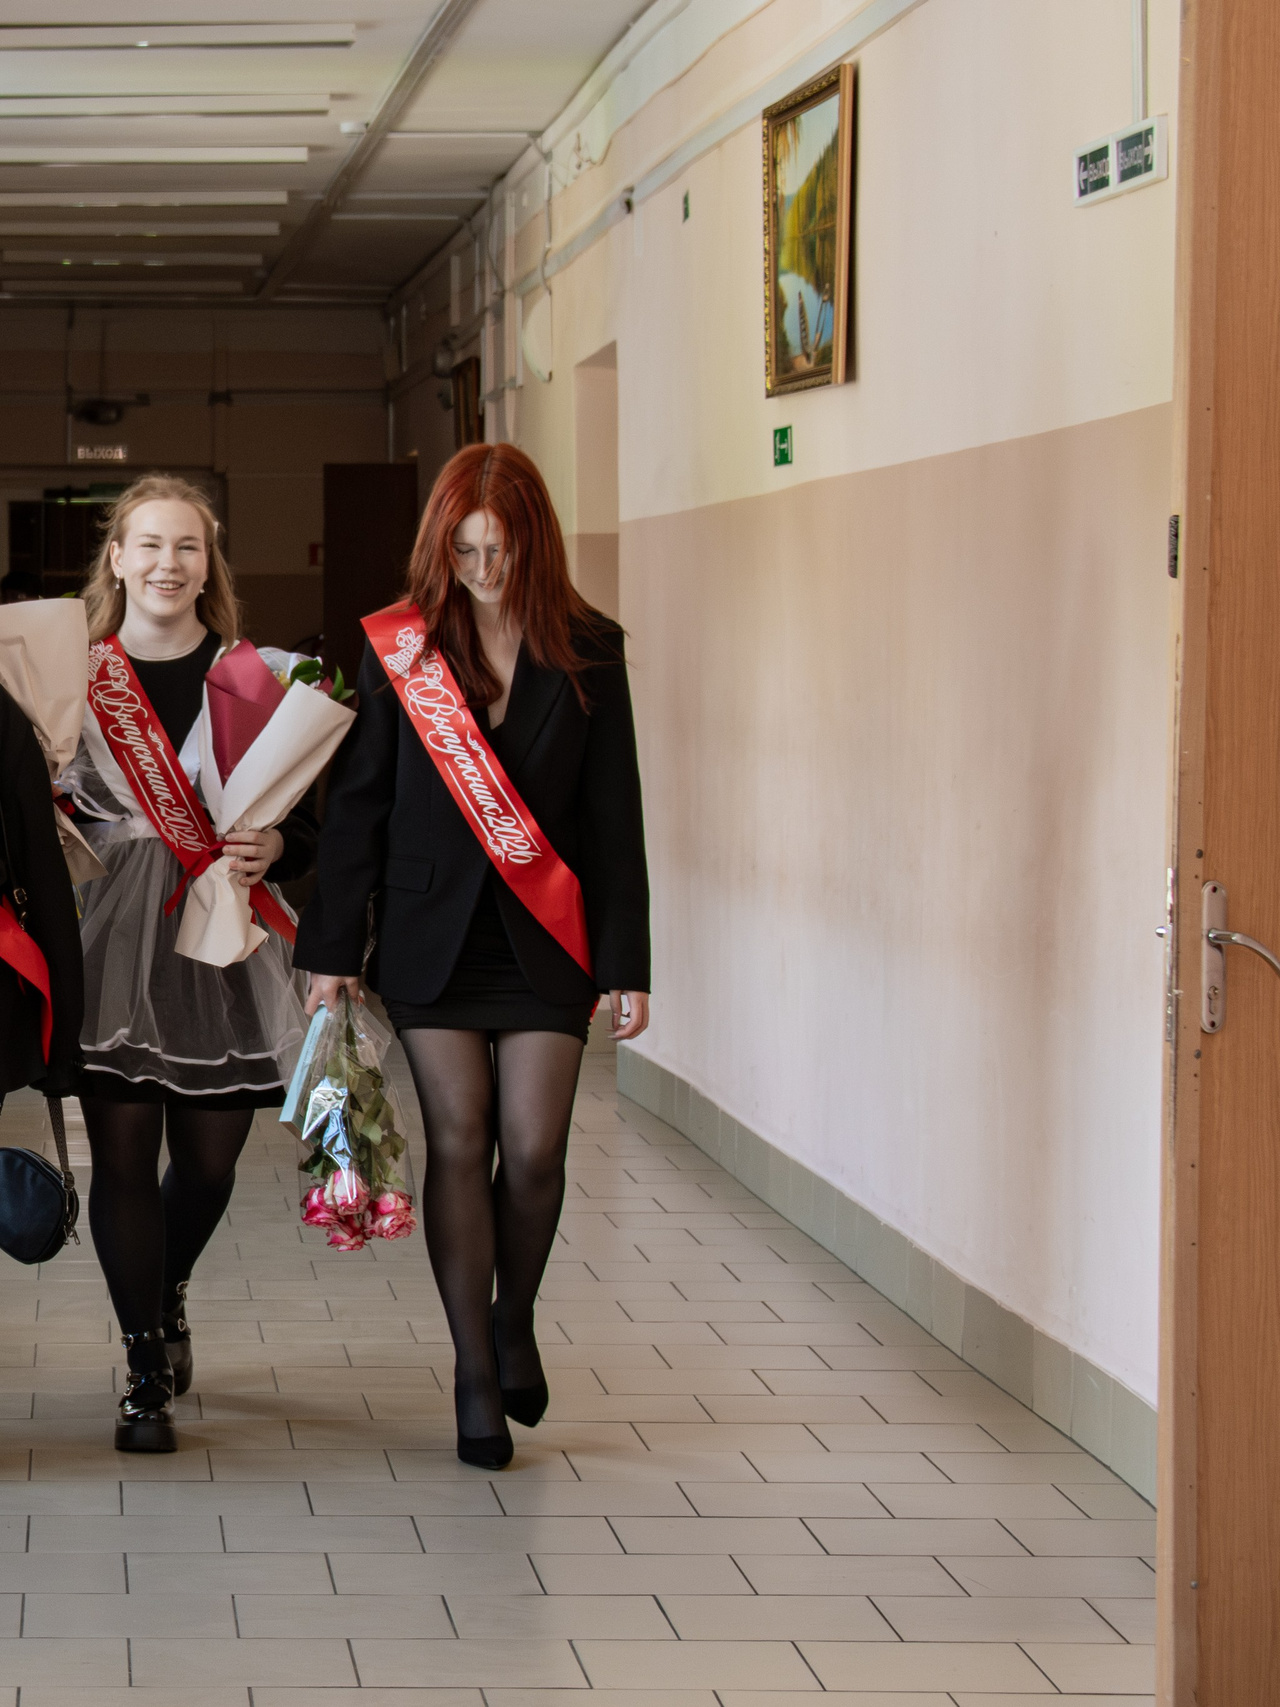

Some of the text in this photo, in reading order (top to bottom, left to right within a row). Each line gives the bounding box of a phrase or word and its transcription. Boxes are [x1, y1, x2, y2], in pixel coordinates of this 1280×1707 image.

[91, 681, 210, 852] Выпускник 2026
[404, 677, 542, 864] Выпускник 2026
